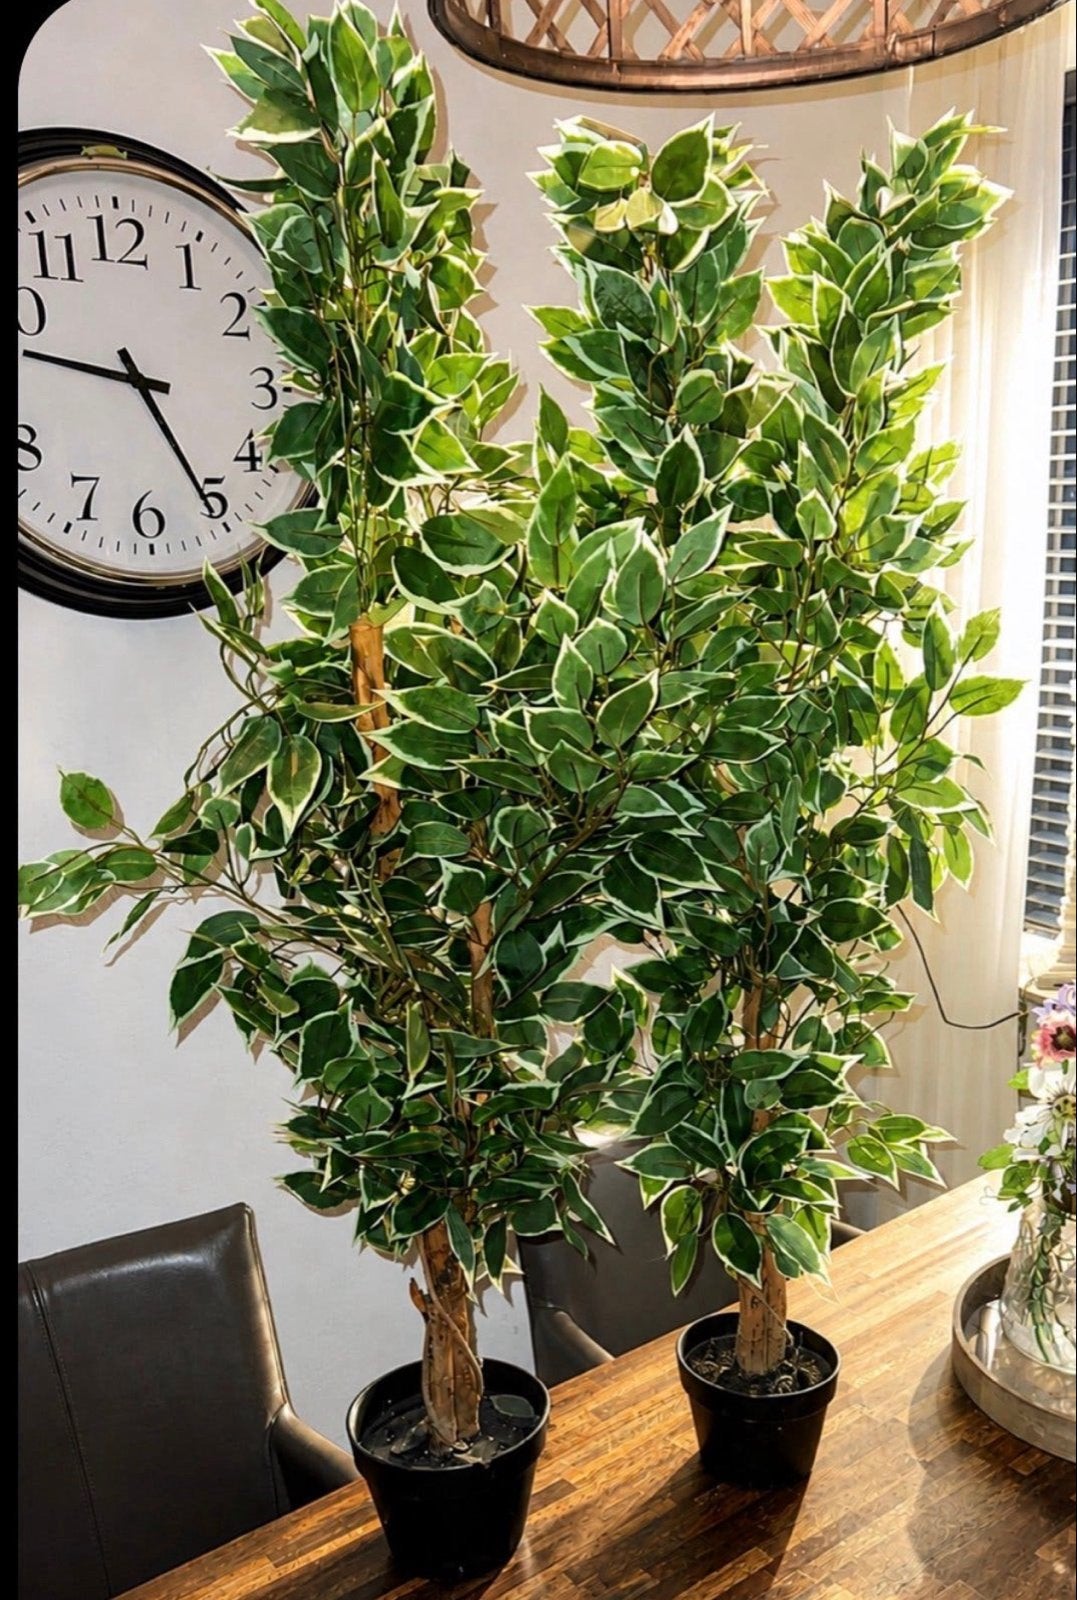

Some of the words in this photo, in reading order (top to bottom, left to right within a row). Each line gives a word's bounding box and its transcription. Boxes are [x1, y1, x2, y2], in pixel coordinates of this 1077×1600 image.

[29, 230, 84, 282] 11
[87, 214, 148, 270] 12
[176, 243, 202, 290] 1
[18, 286, 47, 336] 0
[220, 292, 251, 340] 2
[249, 367, 278, 410] 3
[18, 424, 42, 471] 8
[233, 429, 263, 473] 4
[71, 472, 100, 521] 7
[132, 490, 165, 539] 6
[199, 476, 228, 519] 5
